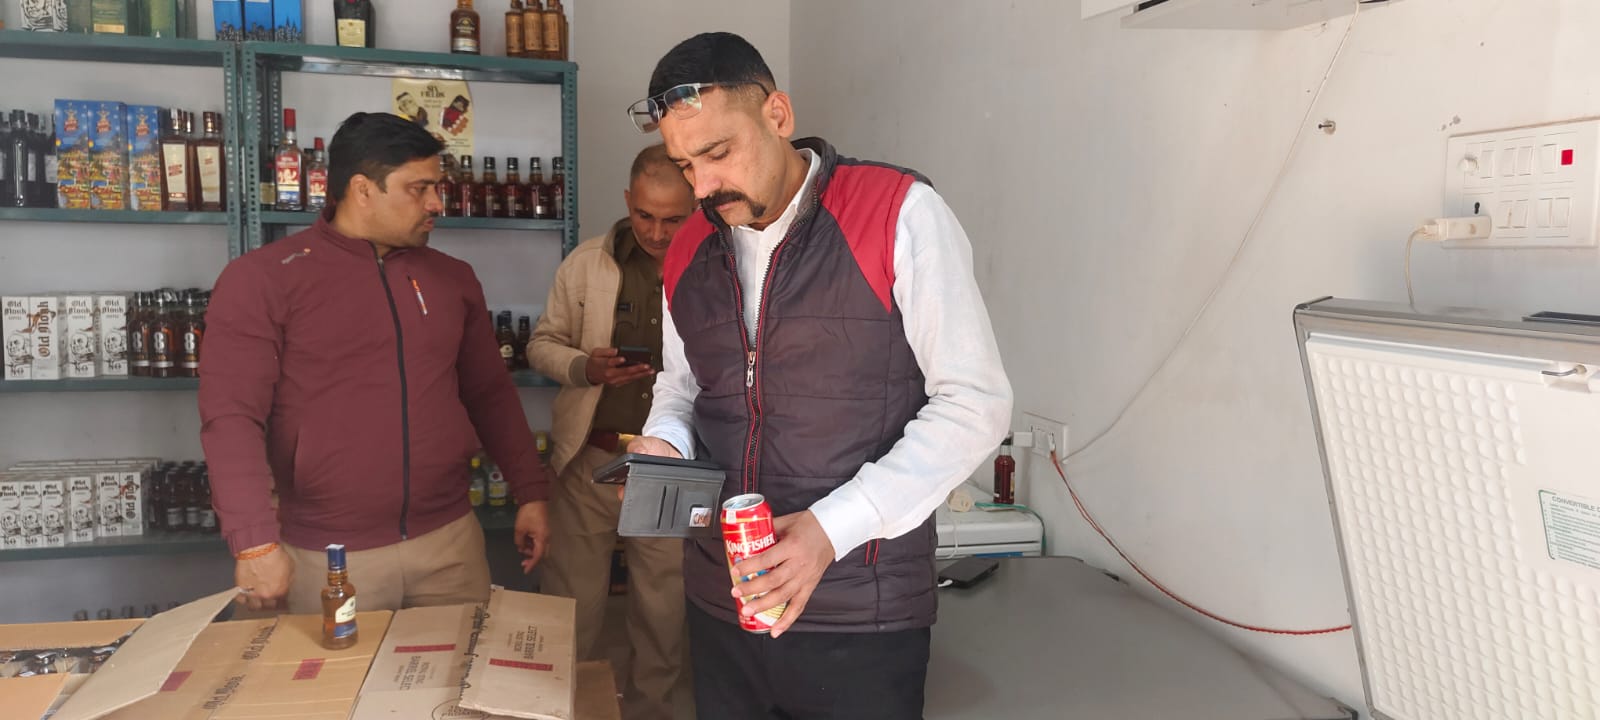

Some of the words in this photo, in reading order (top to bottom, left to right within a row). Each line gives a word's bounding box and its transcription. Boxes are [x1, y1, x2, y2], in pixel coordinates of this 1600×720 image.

[38, 336, 50, 357] Old
[132, 331, 142, 351] 8
[154, 331, 165, 352] 8
[184, 332, 195, 352] 8
